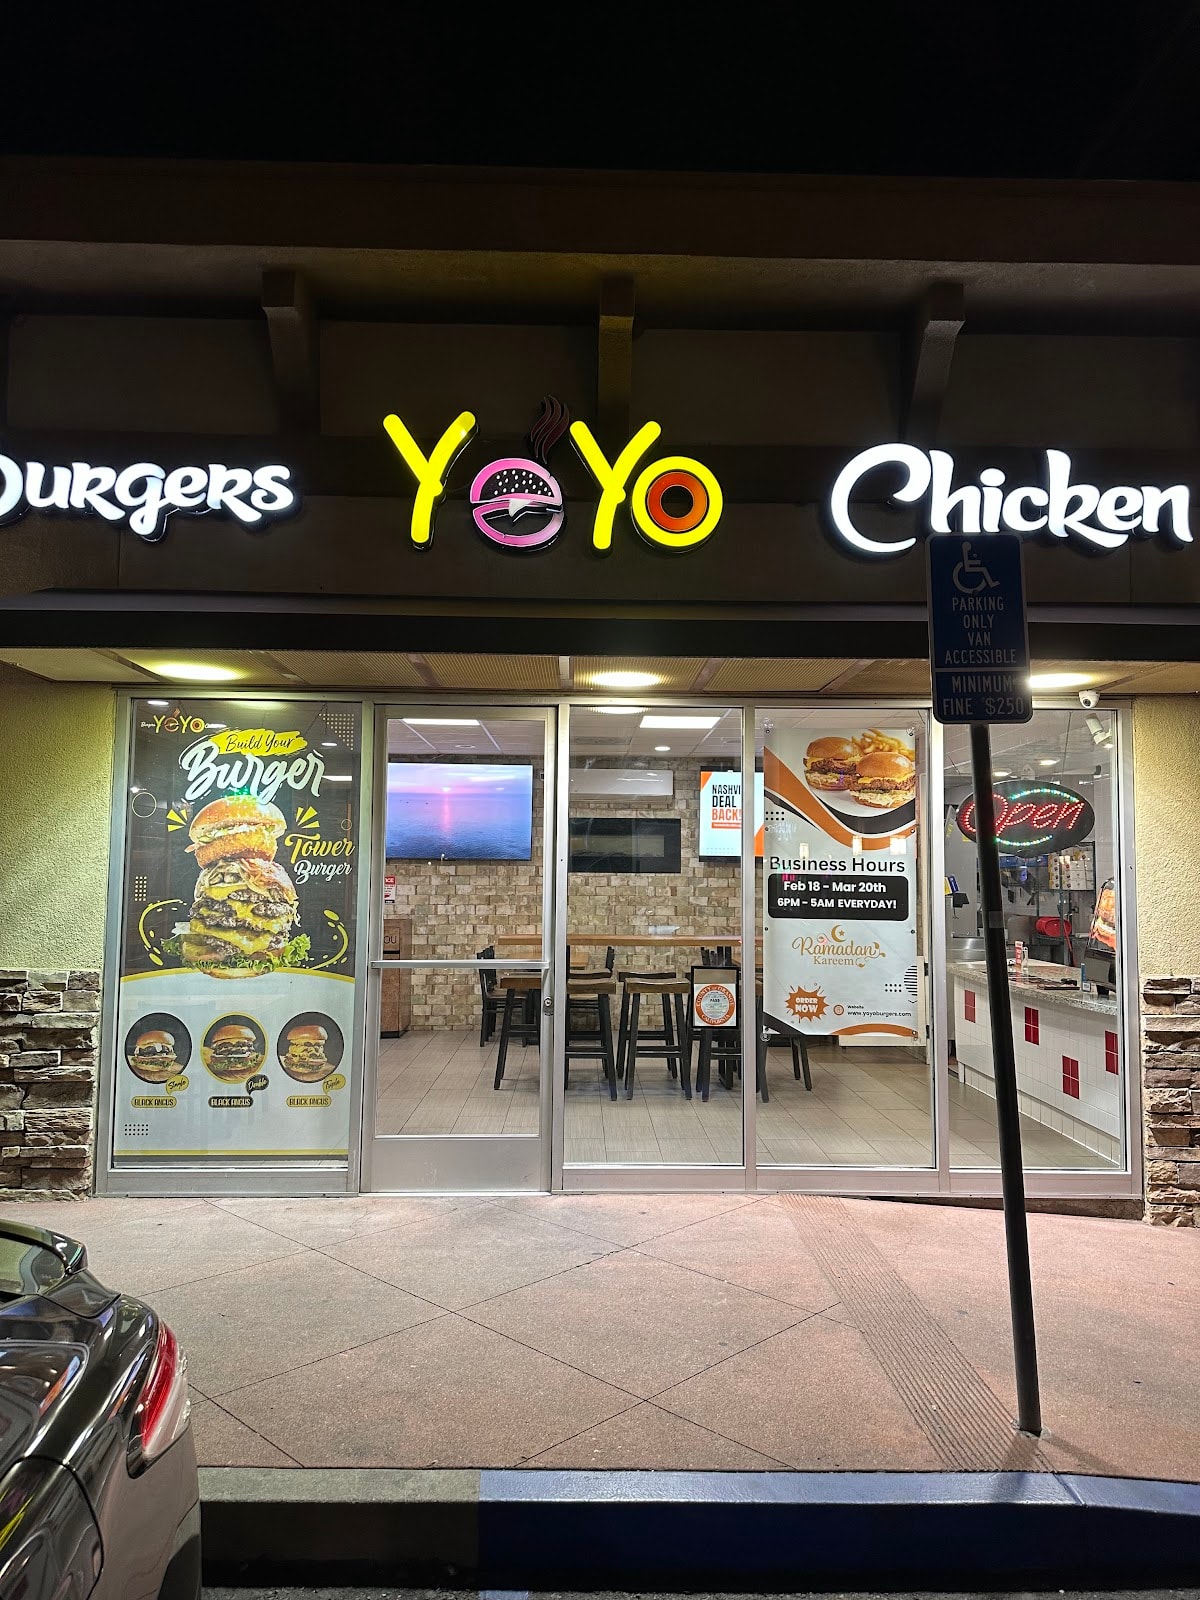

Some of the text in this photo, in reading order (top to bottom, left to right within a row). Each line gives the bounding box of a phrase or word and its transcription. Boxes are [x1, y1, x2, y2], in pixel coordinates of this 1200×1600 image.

[831, 442, 1194, 553] Chicken
[952, 597, 1004, 611] PARKING
[963, 614, 994, 629] ONLY
[967, 632, 991, 646] VAN
[945, 649, 1016, 664] ACCESSIBLE
[952, 675, 1013, 693] MINIMUM
[943, 697, 1024, 716] FINE $250
[226, 733, 295, 752] Build Your
[181, 740, 325, 805] Burger
[712, 785, 741, 795] NASHVI
[712, 796, 737, 808] DEAL
[965, 794, 1085, 837] Open
[285, 833, 355, 864] Tower
[770, 856, 905, 872] Business Hours
[294, 860, 352, 884] Burger
[783, 881, 806, 891] Feb
[808, 881, 821, 891] 18
[832, 882, 856, 892] Mar
[858, 882, 886, 893] 20th
[778, 898, 800, 907] 6PM
[810, 898, 834, 907] 5AM
[838, 899, 897, 909] EVERYDAY!
[383, 936, 397, 944] OU
[792, 936, 880, 956] Ramadan
[813, 956, 854, 966] Kareem
[795, 1004, 818, 1013] NOW
[135, 1098, 153, 1106] BLACK
[211, 1098, 230, 1106] BLACK
[289, 1098, 308, 1106] BLACK
